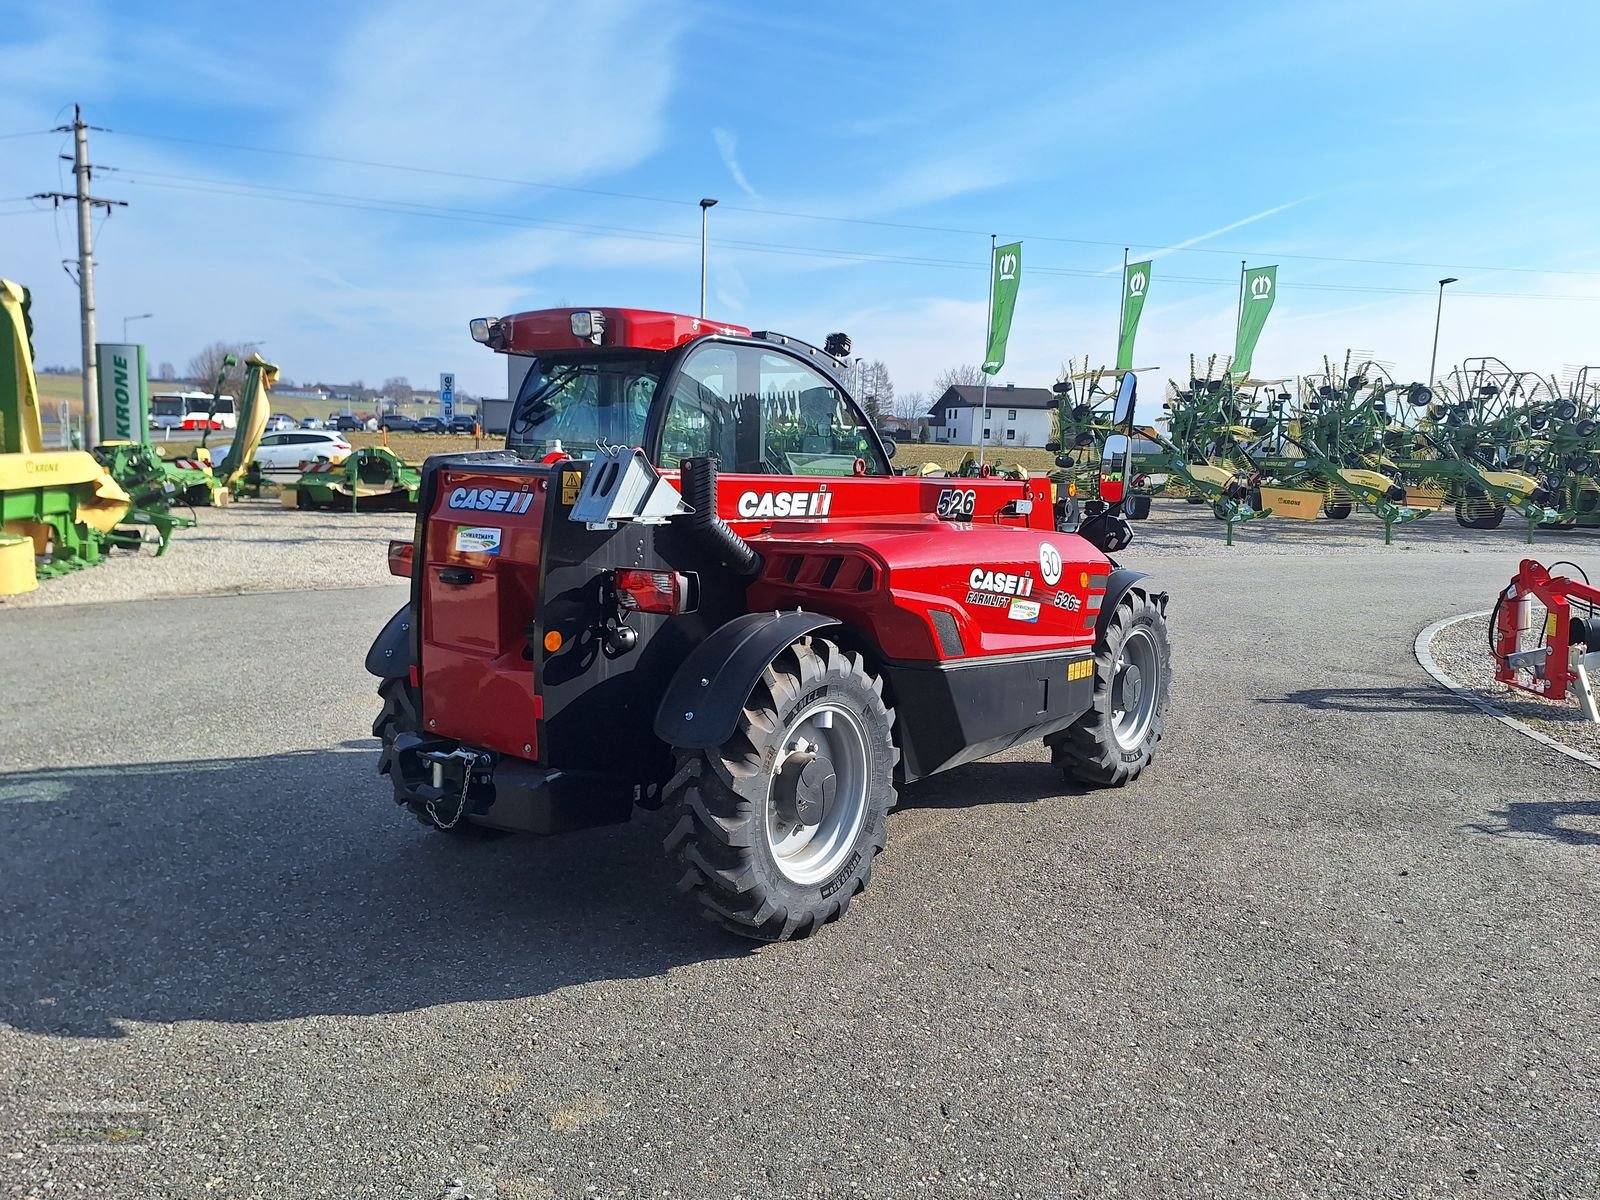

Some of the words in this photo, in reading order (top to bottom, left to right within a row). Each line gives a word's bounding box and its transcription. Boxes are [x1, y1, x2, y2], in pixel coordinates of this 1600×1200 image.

[113, 354, 130, 439] KRONE
[449, 487, 510, 511] CASE
[738, 491, 807, 519] CASE
[937, 488, 976, 517] 526
[1042, 551, 1060, 577] 30
[969, 567, 1017, 595] CASE
[965, 591, 1010, 608] FARMLIFT
[1055, 592, 1076, 611] 526
